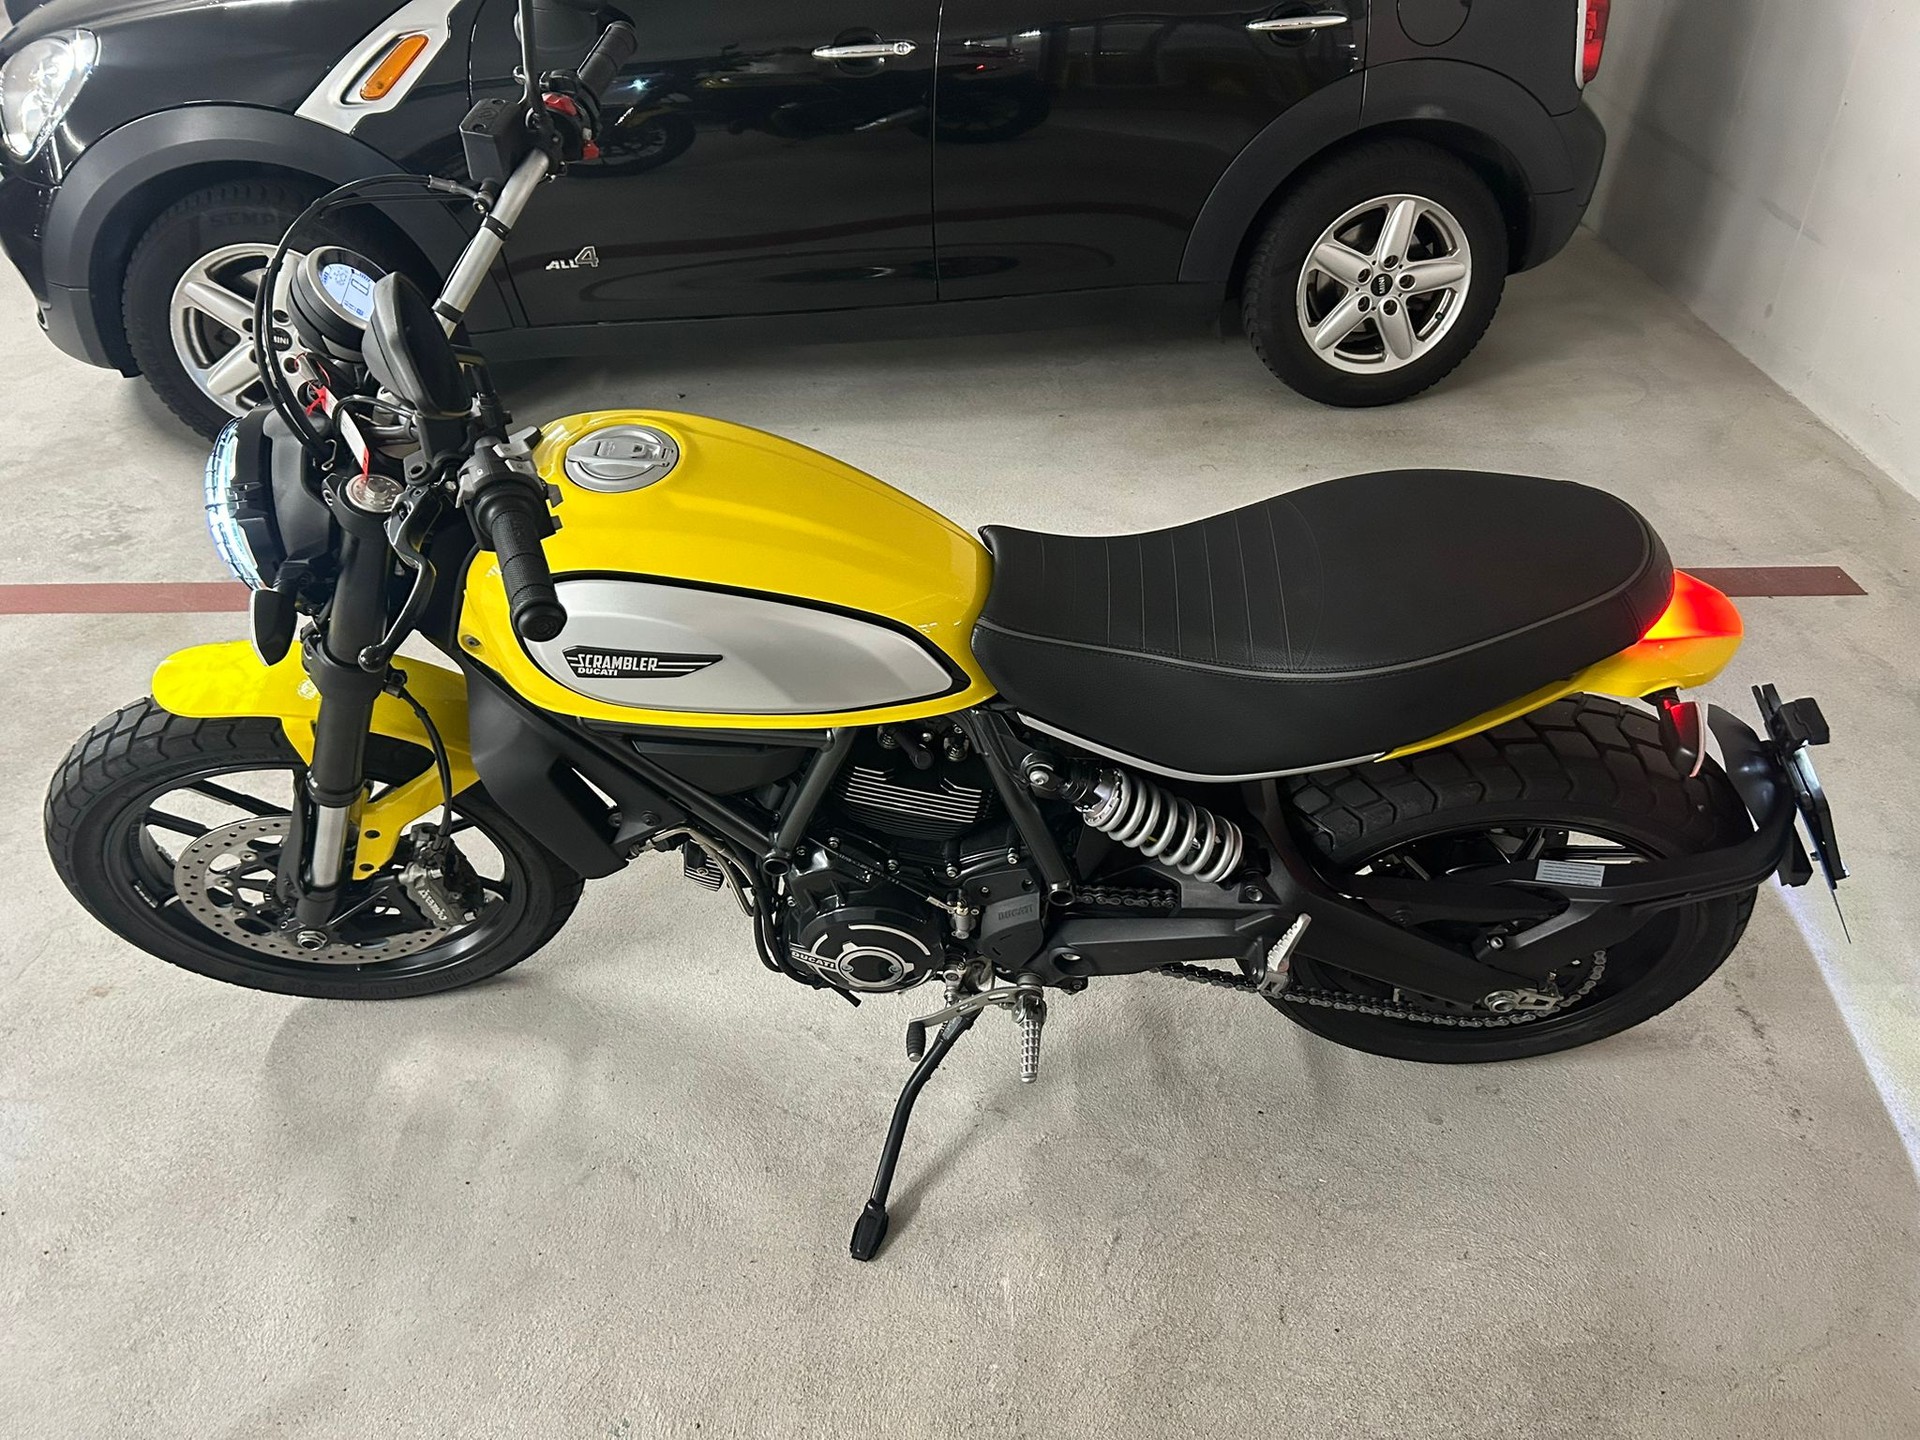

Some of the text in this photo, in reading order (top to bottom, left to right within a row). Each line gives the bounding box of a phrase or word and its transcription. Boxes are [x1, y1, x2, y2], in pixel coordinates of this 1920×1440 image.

[577, 653, 659, 671] SCRAMBLER
[577, 667, 618, 676] DUCATI
[791, 951, 835, 968] DUCATI
